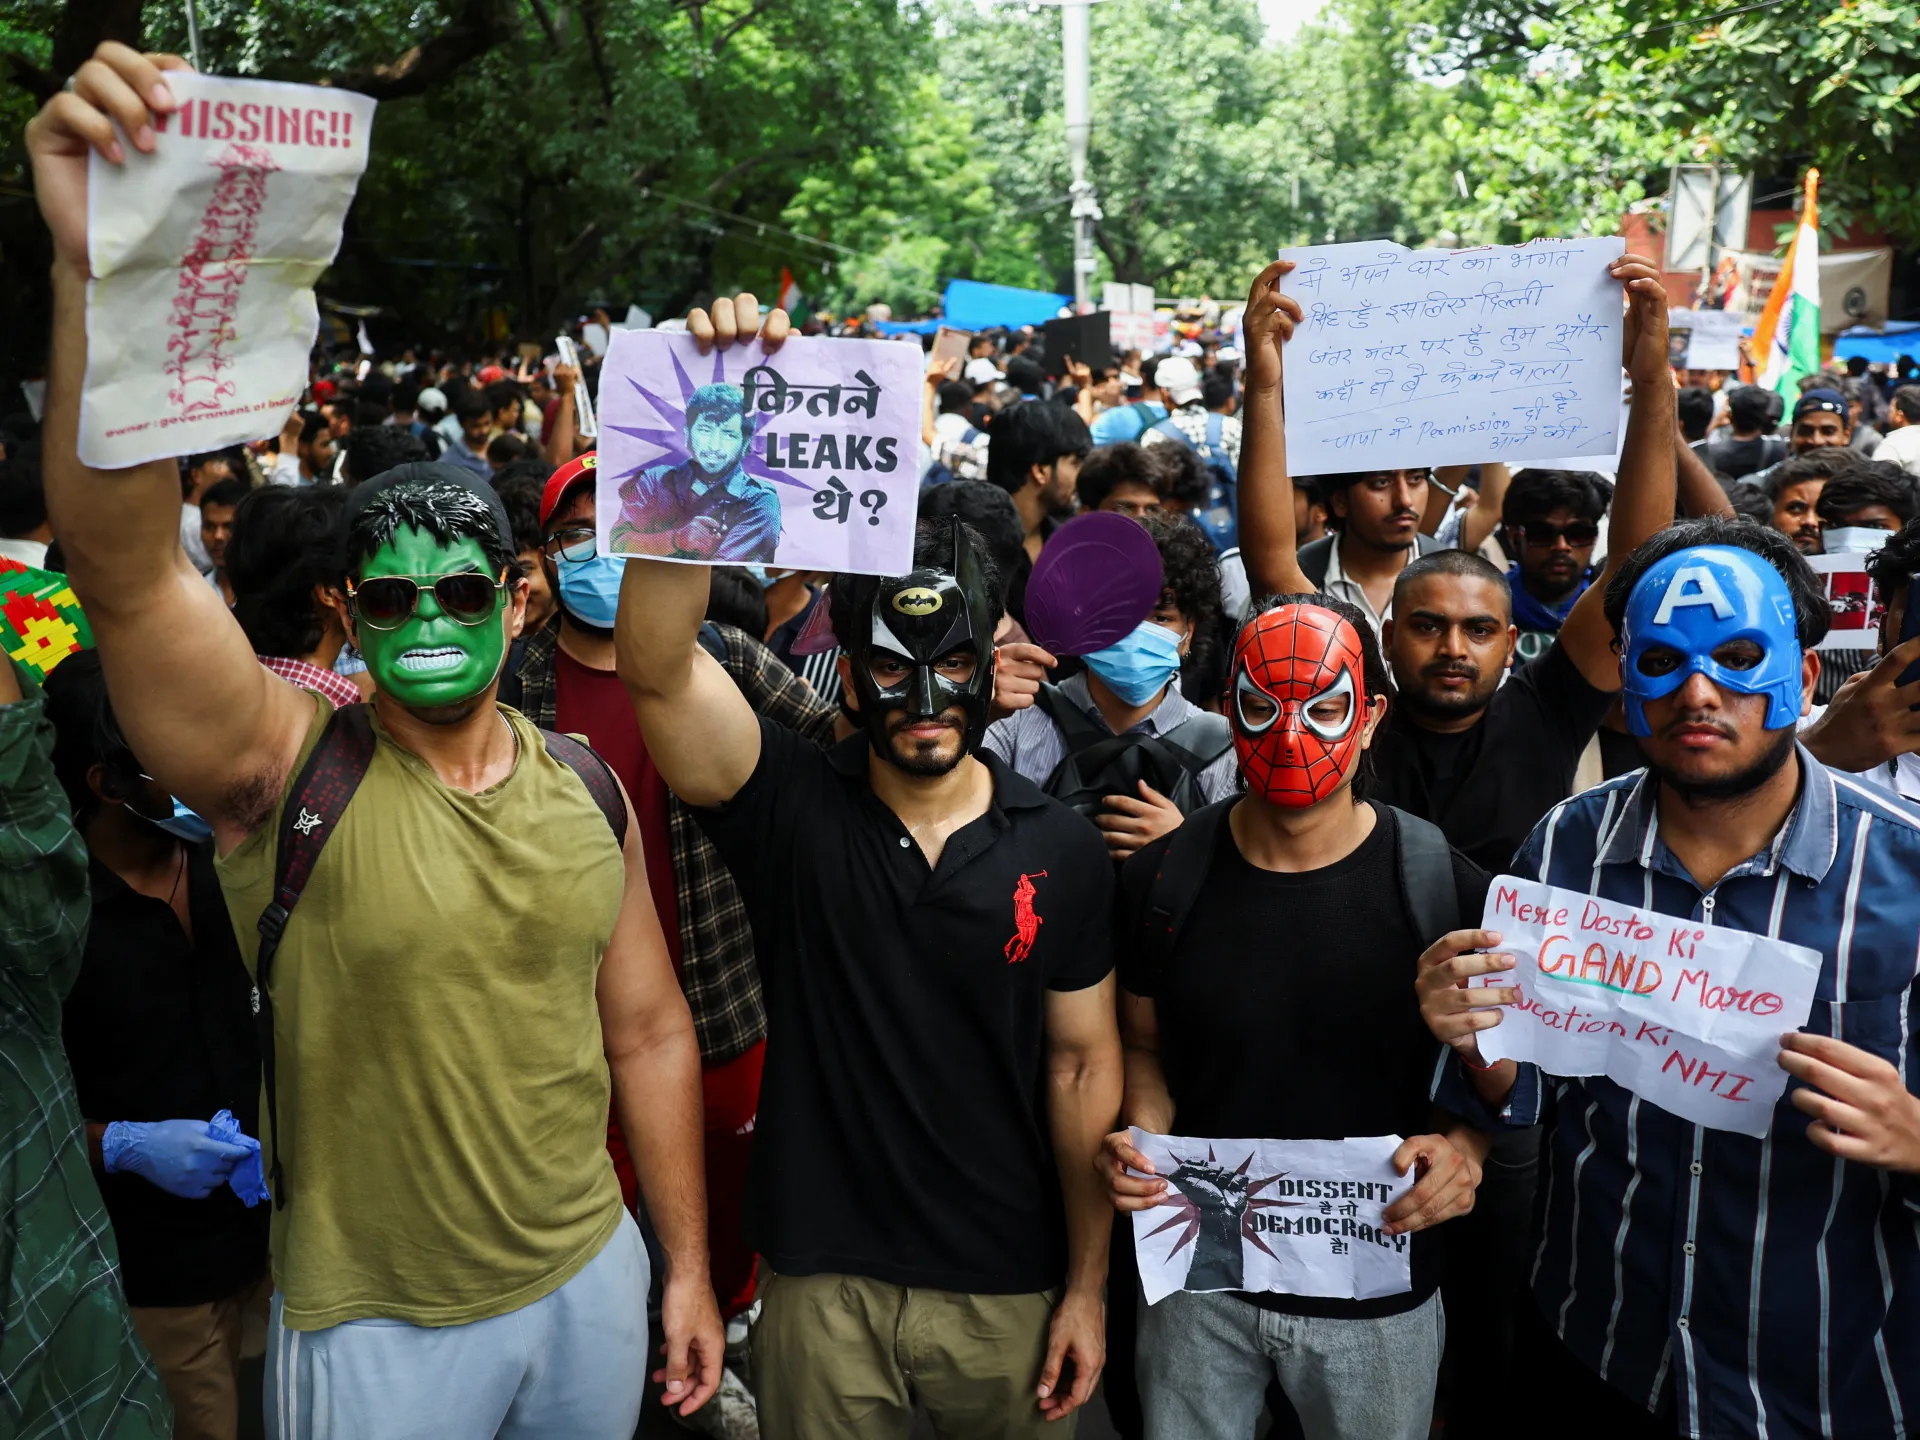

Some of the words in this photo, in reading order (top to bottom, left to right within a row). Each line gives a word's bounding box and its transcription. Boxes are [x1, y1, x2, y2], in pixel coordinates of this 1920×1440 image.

[155, 97, 353, 149] MISSING!!
[1340, 252, 1401, 290] अपने
[1408, 258, 1450, 279] घर
[1462, 257, 1500, 272] का
[1511, 250, 1584, 272] भगत
[1474, 280, 1553, 314] दिल्ली
[1309, 346, 1351, 366] जंतर
[1420, 338, 1454, 356] पर
[1500, 325, 1545, 351] तुम
[740, 365, 882, 419] कितने
[1316, 379, 1364, 403] कहाँ
[1370, 368, 1395, 404] हो
[1509, 359, 1583, 383] वाला
[160, 406, 251, 428] government
[254, 402, 266, 411] of
[1322, 428, 1382, 448] पापा
[1389, 416, 1412, 440] ने
[1417, 411, 1510, 445] Permission
[1513, 397, 1549, 423] दी
[1490, 425, 1537, 449] आने
[1543, 417, 1588, 439] की
[765, 432, 898, 473] LEAKS
[1653, 566, 1736, 625] A
[1496, 885, 1568, 927] Mere
[1580, 899, 1654, 941] Dosto
[1538, 935, 1663, 994] GAND
[1671, 968, 1784, 1015] Maro
[1484, 976, 1627, 1037] ucation
[1662, 1050, 1755, 1102] NHI
[1278, 1179, 1393, 1204] DISSENT
[1319, 1201, 1333, 1215] है
[1338, 1200, 1359, 1217] तो
[1252, 1212, 1407, 1254] DEMOCRACY
